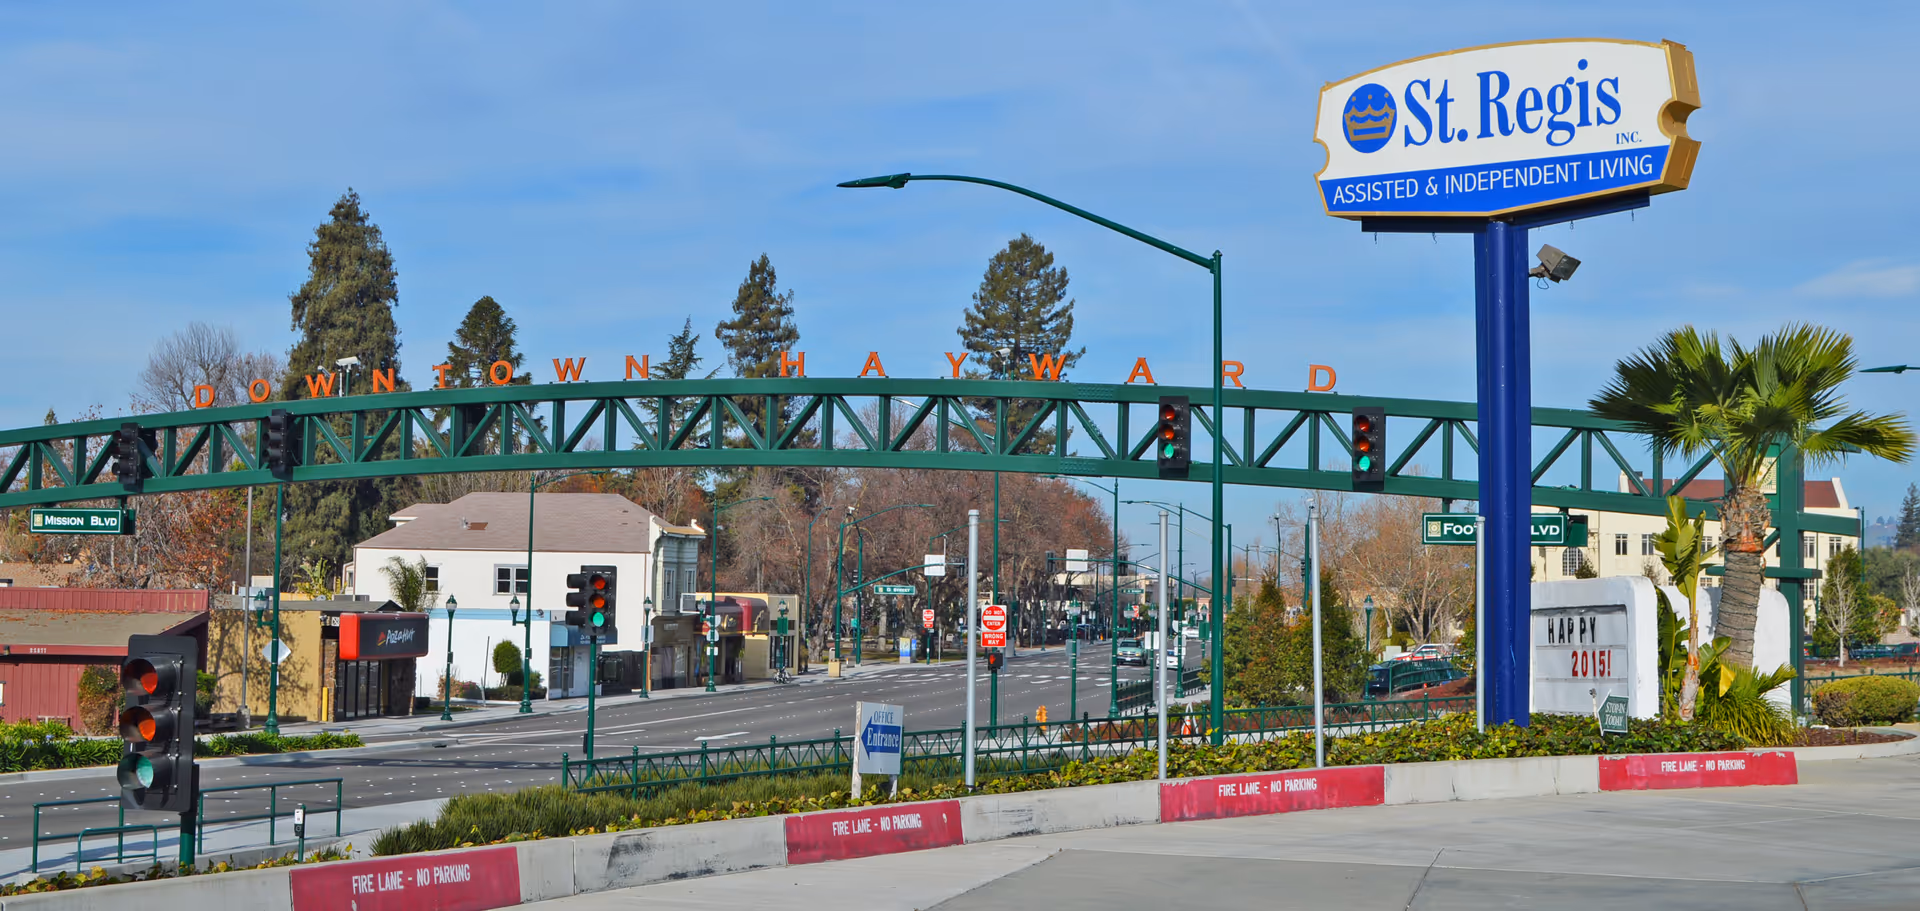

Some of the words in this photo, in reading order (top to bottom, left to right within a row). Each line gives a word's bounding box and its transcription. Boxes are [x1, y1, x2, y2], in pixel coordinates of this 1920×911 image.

[1404, 78, 1469, 148] St.
[1476, 58, 1622, 147] Regis
[1615, 131, 1643, 145] INC.
[1333, 177, 1419, 205] ASSISTED
[1425, 176, 1438, 195] &
[1444, 161, 1582, 195] INDEPENDENT
[1588, 154, 1654, 181] LIVING
[193, 354, 649, 408] DOWNTOWN
[779, 351, 1337, 392] HAYWARD
[44, 515, 84, 526] MISSION
[1548, 617, 1596, 643] HAPPY
[1571, 649, 1612, 678] 2015!
[873, 710, 894, 724] OFFICE
[1605, 714, 1624, 726] TODAY
[867, 727, 899, 747] Entrance
[1661, 760, 1677, 772] FIRE
[1679, 759, 1698, 772] LANE
[1705, 759, 1716, 771] NO
[1717, 759, 1746, 770] PARKING
[1218, 783, 1237, 797] FIRE
[1239, 781, 1261, 796] LANE
[1270, 779, 1282, 793] NO
[1284, 777, 1317, 792] PARKING
[832, 821, 850, 836] FIRE
[851, 818, 872, 835] LANE
[880, 815, 891, 831] NO
[892, 813, 922, 830] PARKING
[352, 873, 375, 894] FIRE
[378, 870, 404, 892] LANE
[416, 867, 430, 887] NO
[433, 863, 471, 884] PARKING
